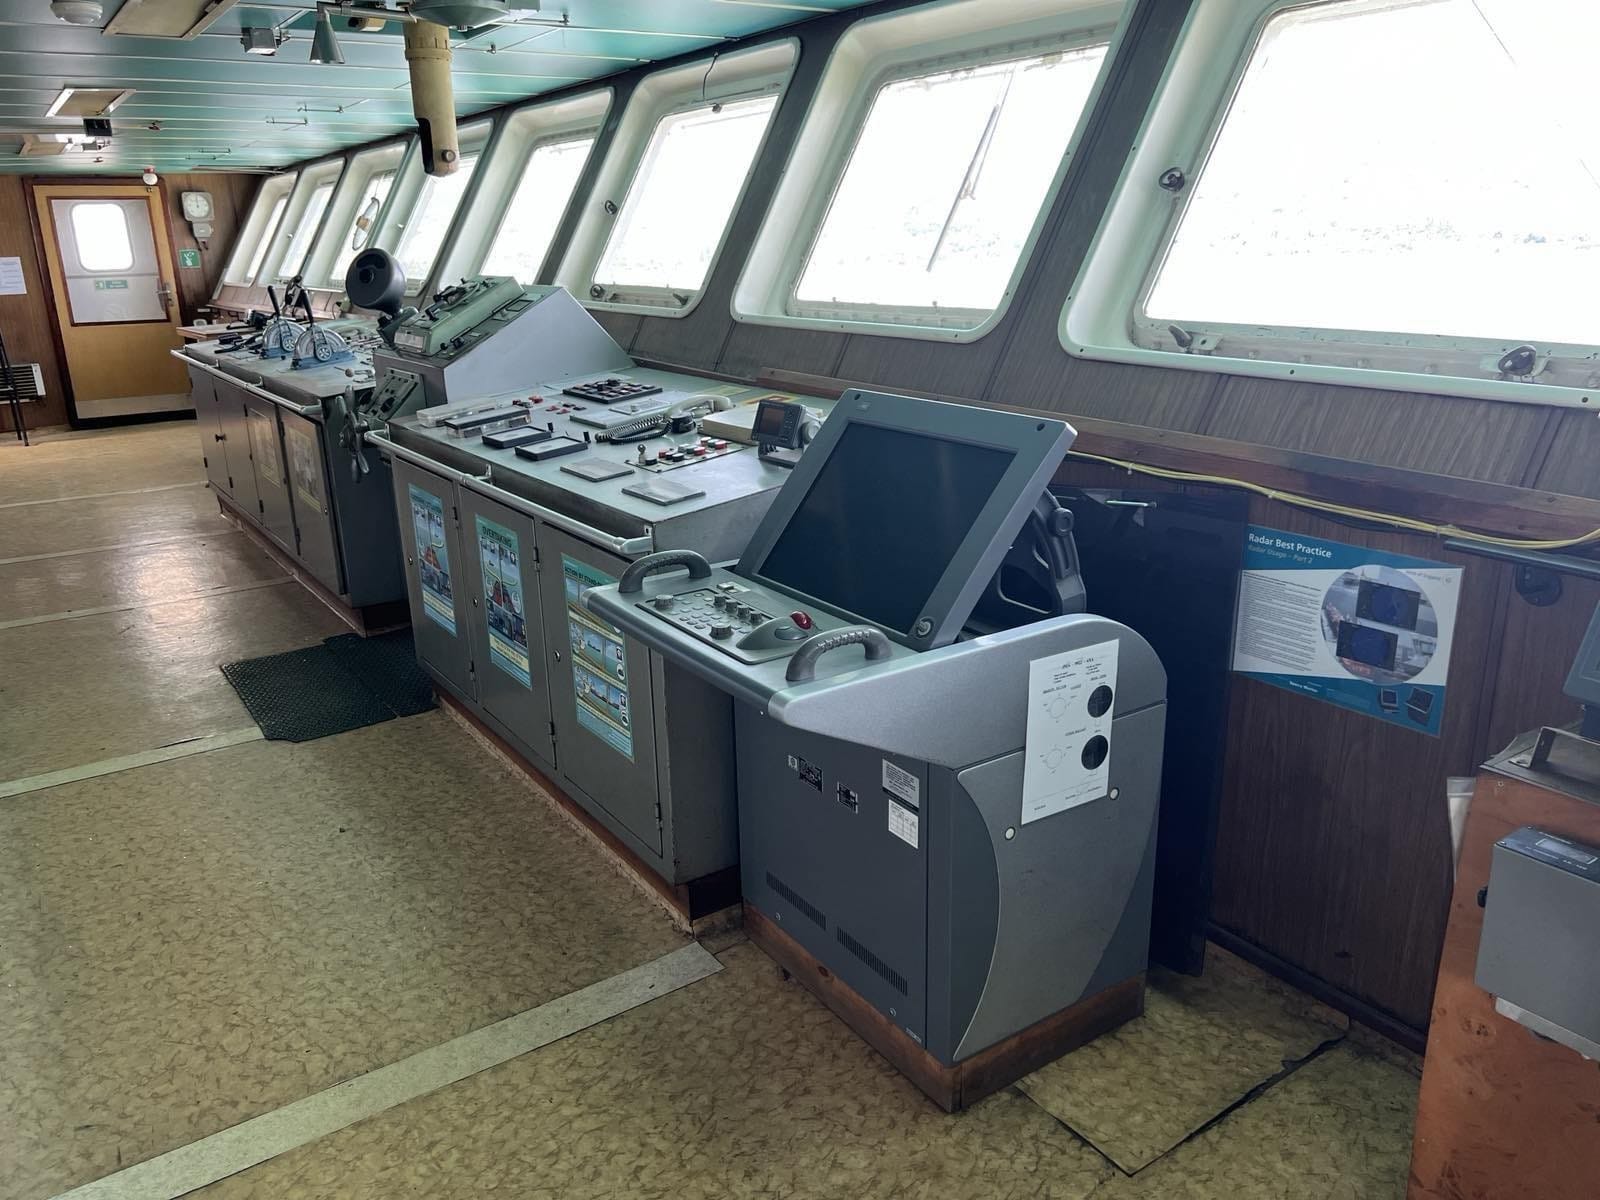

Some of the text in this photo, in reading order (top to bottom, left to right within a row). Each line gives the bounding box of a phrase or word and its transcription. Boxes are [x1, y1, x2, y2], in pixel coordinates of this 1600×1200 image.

[482, 526, 512, 548] OVERTAKING
[1248, 533, 1332, 558] Radar Best Practice
[1248, 545, 1266, 553] Radar
[1293, 554, 1307, 563] Part
